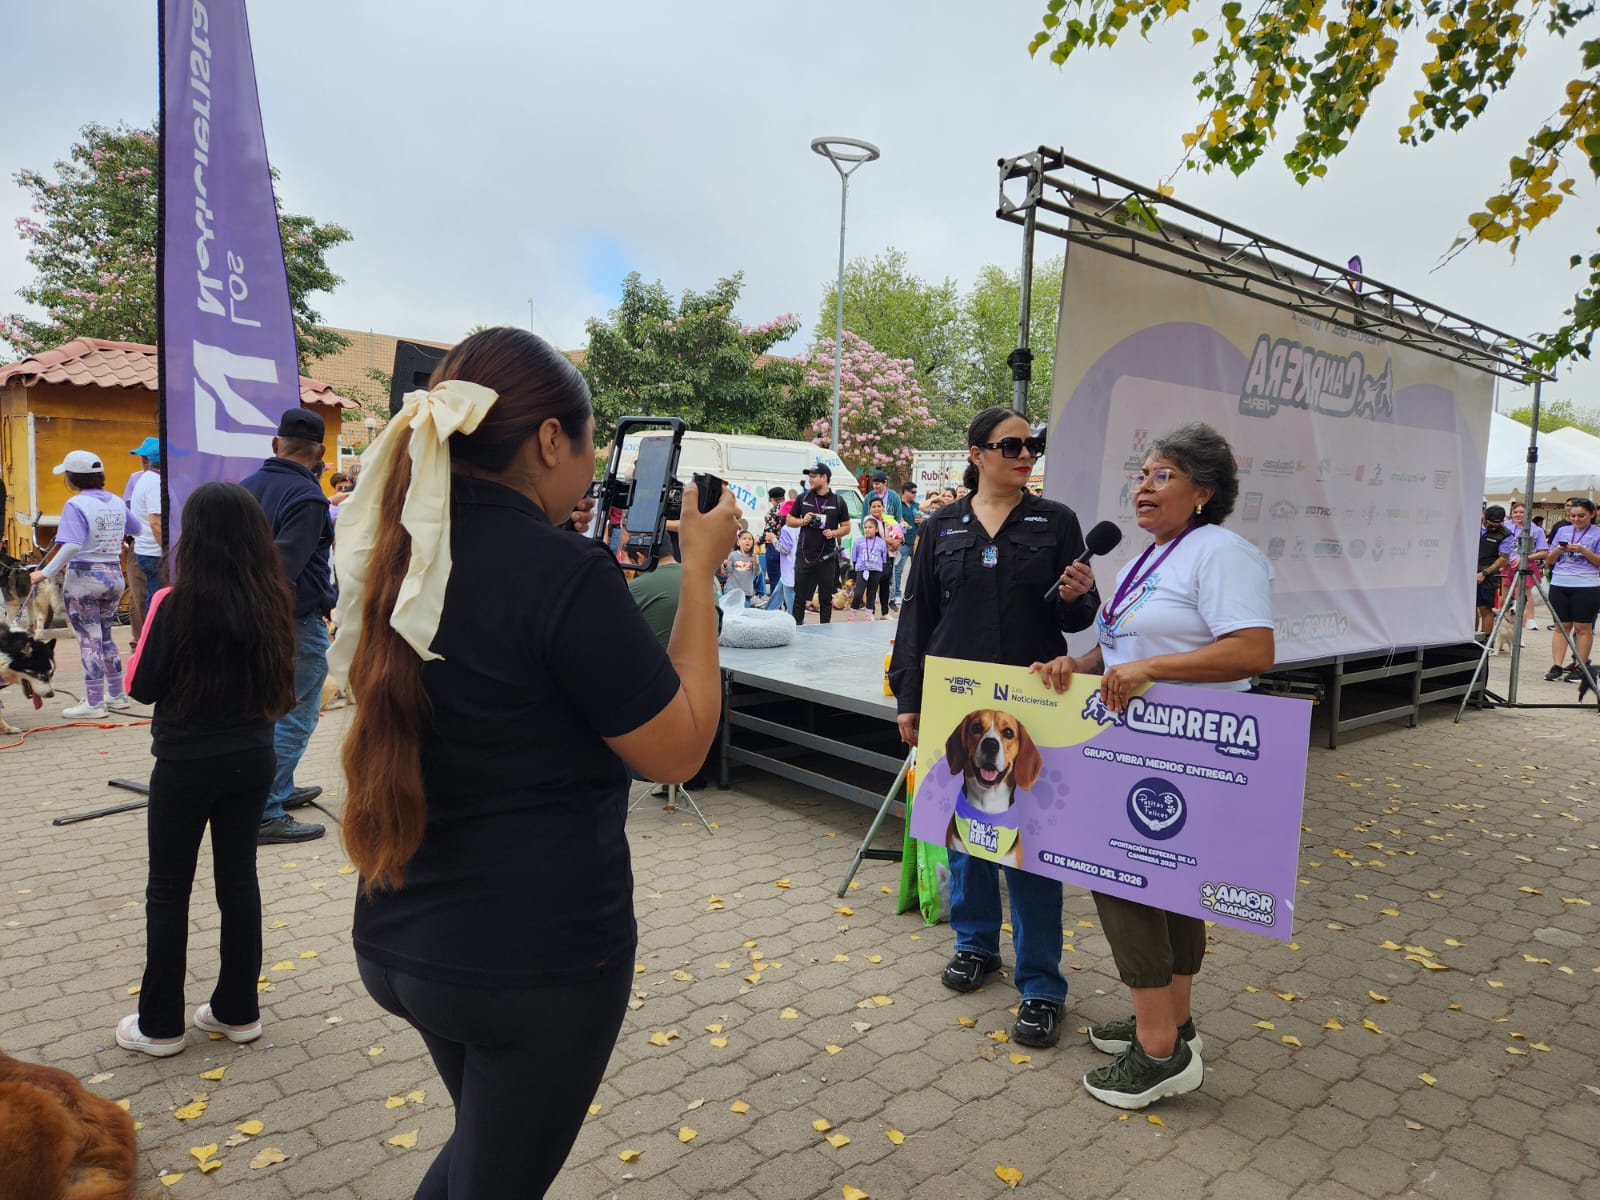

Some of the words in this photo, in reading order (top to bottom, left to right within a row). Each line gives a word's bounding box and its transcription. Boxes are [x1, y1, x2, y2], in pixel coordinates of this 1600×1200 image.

[944, 676, 981, 689] VIBRA
[950, 686, 974, 696] 89.7
[1012, 686, 1024, 694] Los
[1011, 694, 1058, 708] Noticieristas
[1126, 698, 1259, 748] CANRRERA
[1083, 747, 1114, 762] GRUPO
[1116, 752, 1144, 767] VIBRA
[1145, 757, 1185, 774] MEDIOS
[1186, 765, 1234, 782] ENTREGA
[1235, 773, 1248, 785] A:
[1138, 793, 1164, 809] Patitas
[970, 819, 986, 832] CAN
[969, 830, 997, 850] RRERA
[1148, 848, 1177, 861] ESPECIAL
[1177, 855, 1187, 864] DE
[1187, 857, 1196, 866] LA
[1043, 852, 1053, 863] 01
[1054, 855, 1066, 866] DE
[1066, 858, 1099, 875] MARZO
[1100, 867, 1117, 880] DEL
[1118, 872, 1143, 887] 2026
[1215, 885, 1274, 913] AMOR
[1213, 902, 1272, 924] ABANDONO
